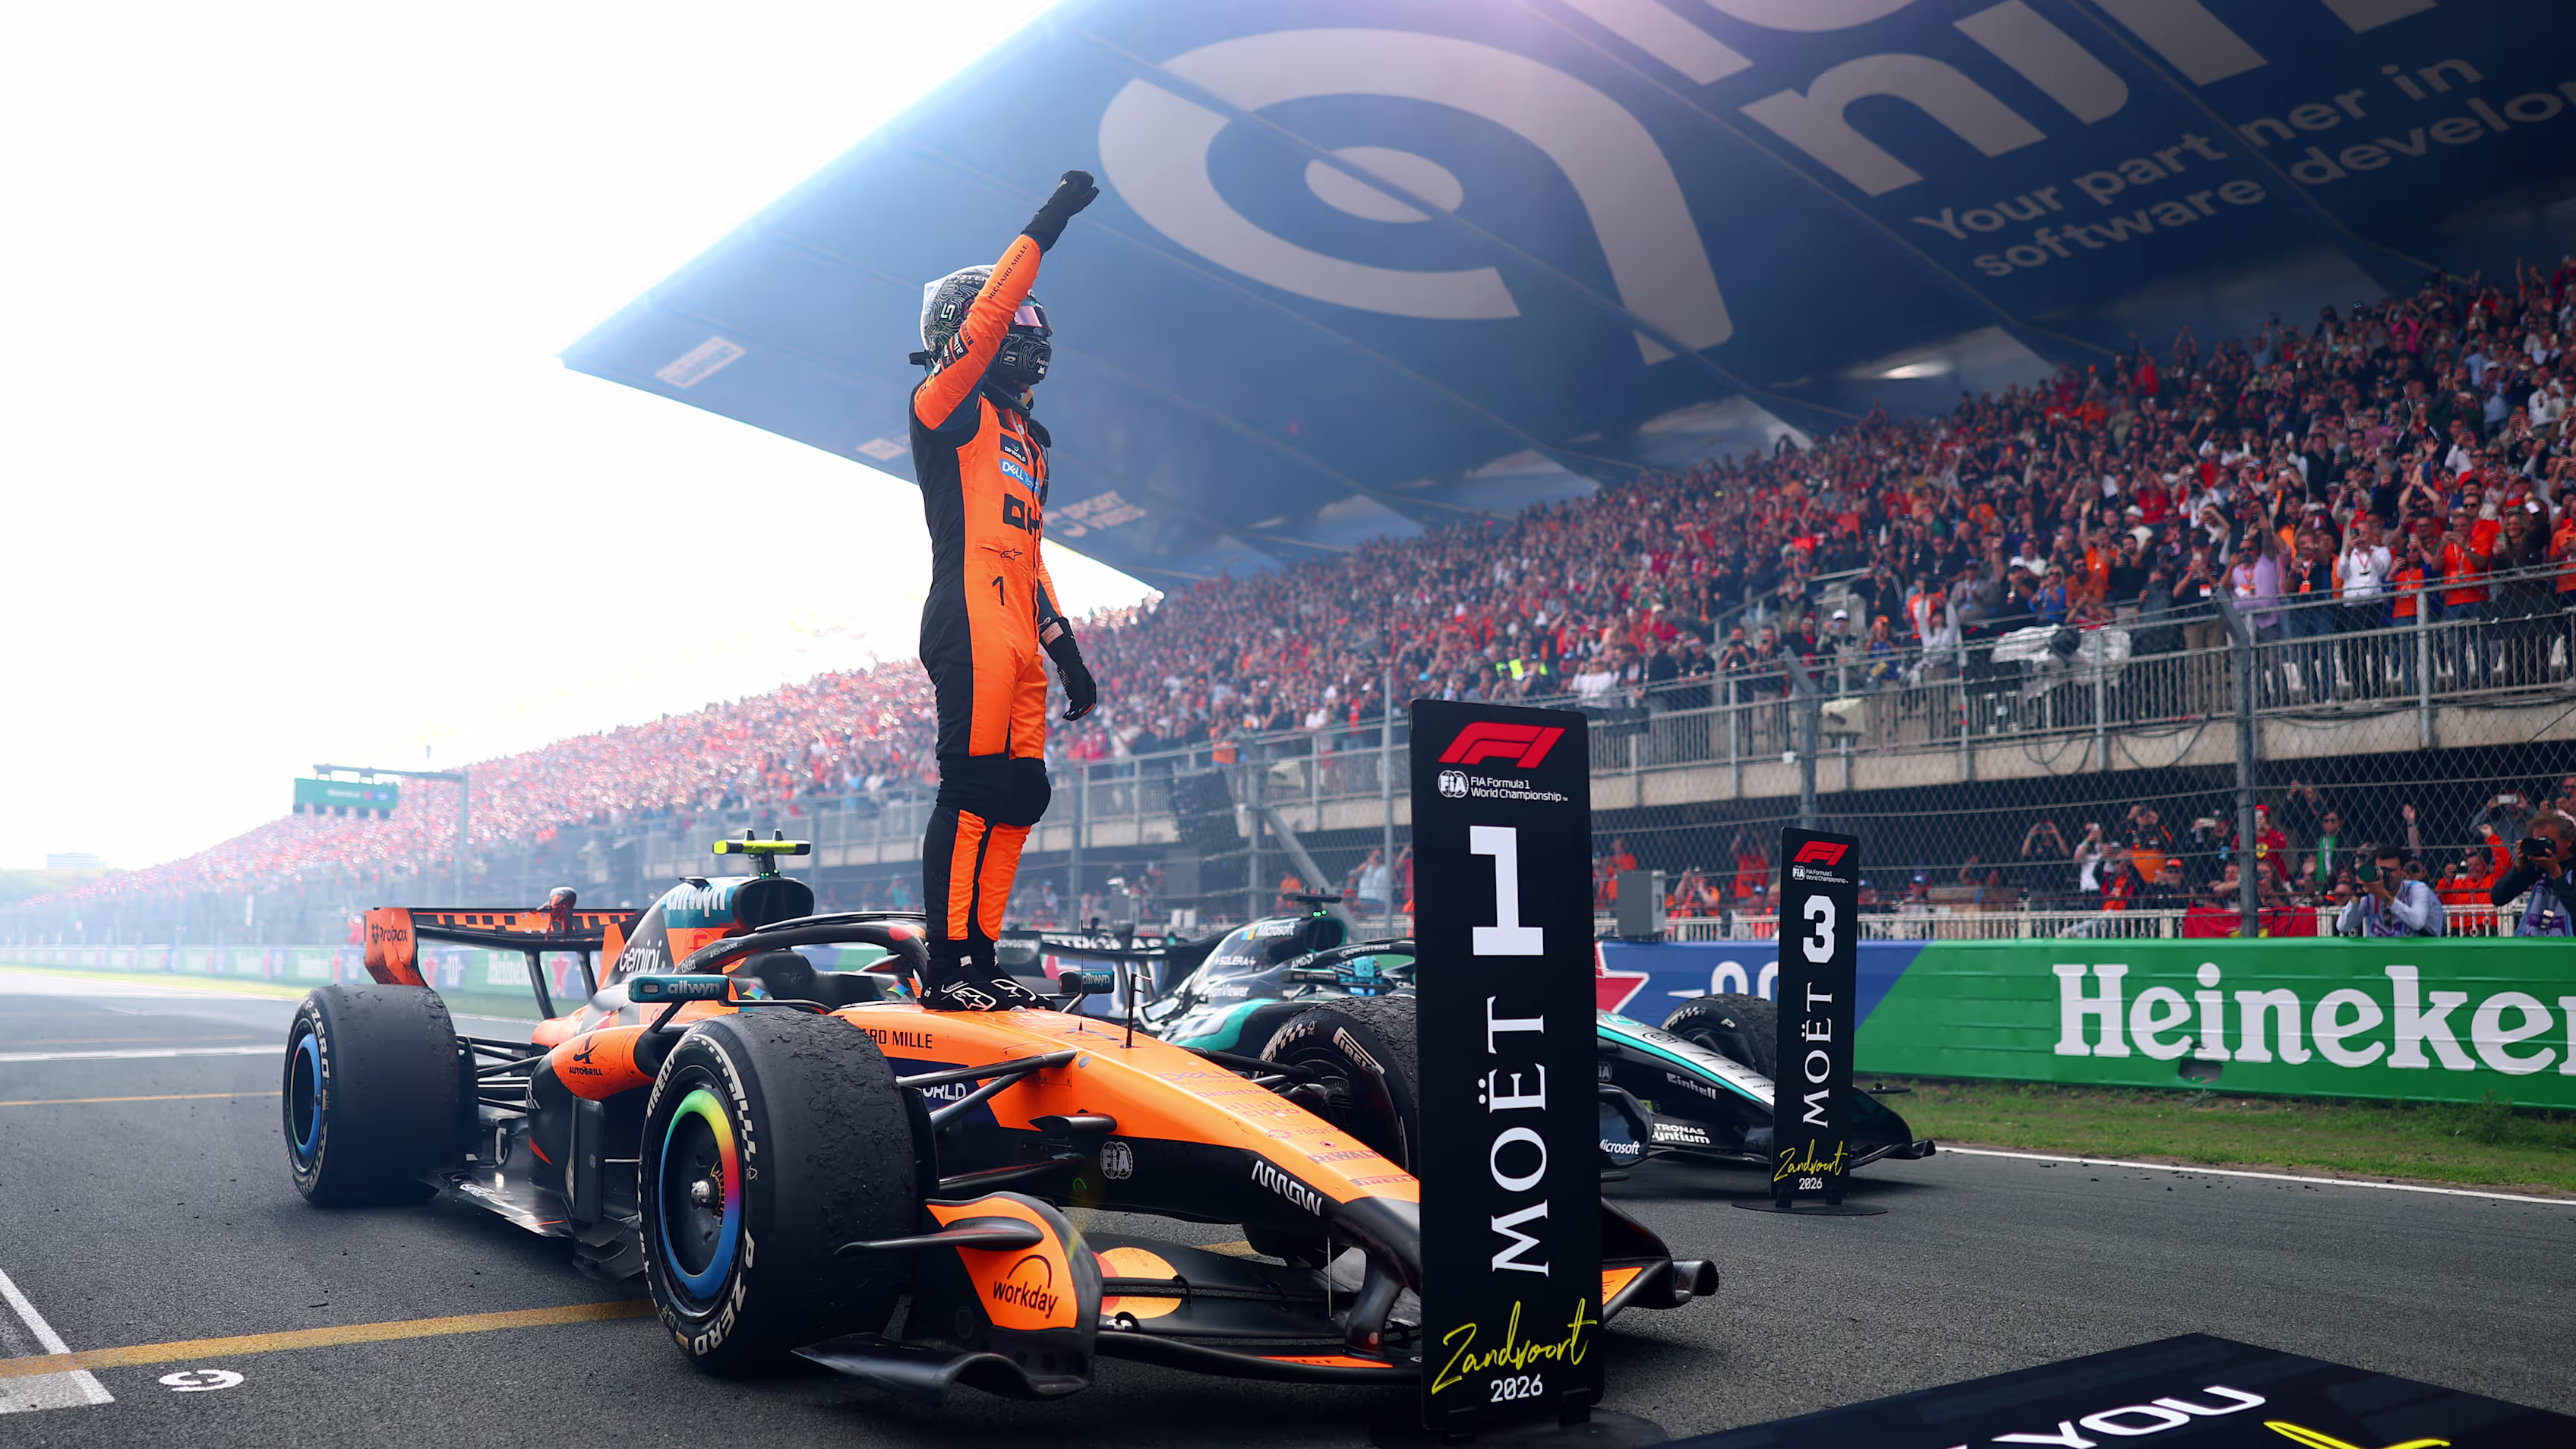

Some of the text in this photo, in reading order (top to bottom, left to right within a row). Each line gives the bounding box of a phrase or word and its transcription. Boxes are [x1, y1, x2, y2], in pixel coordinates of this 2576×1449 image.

[1911, 186, 2063, 240] Your
[2382, 58, 2483, 102] in
[1974, 81, 2576, 276] software develo
[1012, 242, 1028, 267] MILLE
[1002, 461, 1023, 481] DELL
[992, 576, 1005, 606] 1
[1471, 777, 1530, 790] FIA Formula 1
[1471, 787, 1498, 798] World
[1499, 788, 1562, 803] Championship
[666, 885, 728, 917] allwyn
[1470, 825, 1544, 956] 1
[1255, 922, 1296, 937] Microsoft
[1802, 895, 1836, 963] 3
[619, 939, 662, 974] Gemini
[1218, 955, 1249, 967] SOLERA
[1291, 955, 1309, 968] AMD
[1341, 944, 1391, 957] CROWDSTRIKE
[680, 959, 696, 974] okta
[1082, 972, 1111, 987] allwyn
[668, 980, 720, 996] allwyn
[2053, 962, 2576, 1076] Heineke
[305, 999, 330, 1079] P ZERO
[892, 1031, 933, 1049] MILLE
[1801, 981, 1833, 1129] MOËT
[569, 1065, 603, 1076] AUTOGRILL
[1157, 1071, 1237, 1081] DELL
[923, 1083, 967, 1101] ORLD
[1665, 1072, 1716, 1100] Einhell
[1478, 996, 1549, 1277] MOËT
[1653, 1122, 1706, 1135] TRONAS
[1774, 1139, 1848, 1182] Zandvoort
[1798, 1177, 1823, 1190] 2026
[694, 1227, 755, 1356] P ZERO
[993, 1280, 1059, 1319] workday
[1432, 1298, 1598, 1394] Zandvoort
[1490, 1373, 1543, 1403] 2026
[1991, 1385, 2267, 1449] YOU
